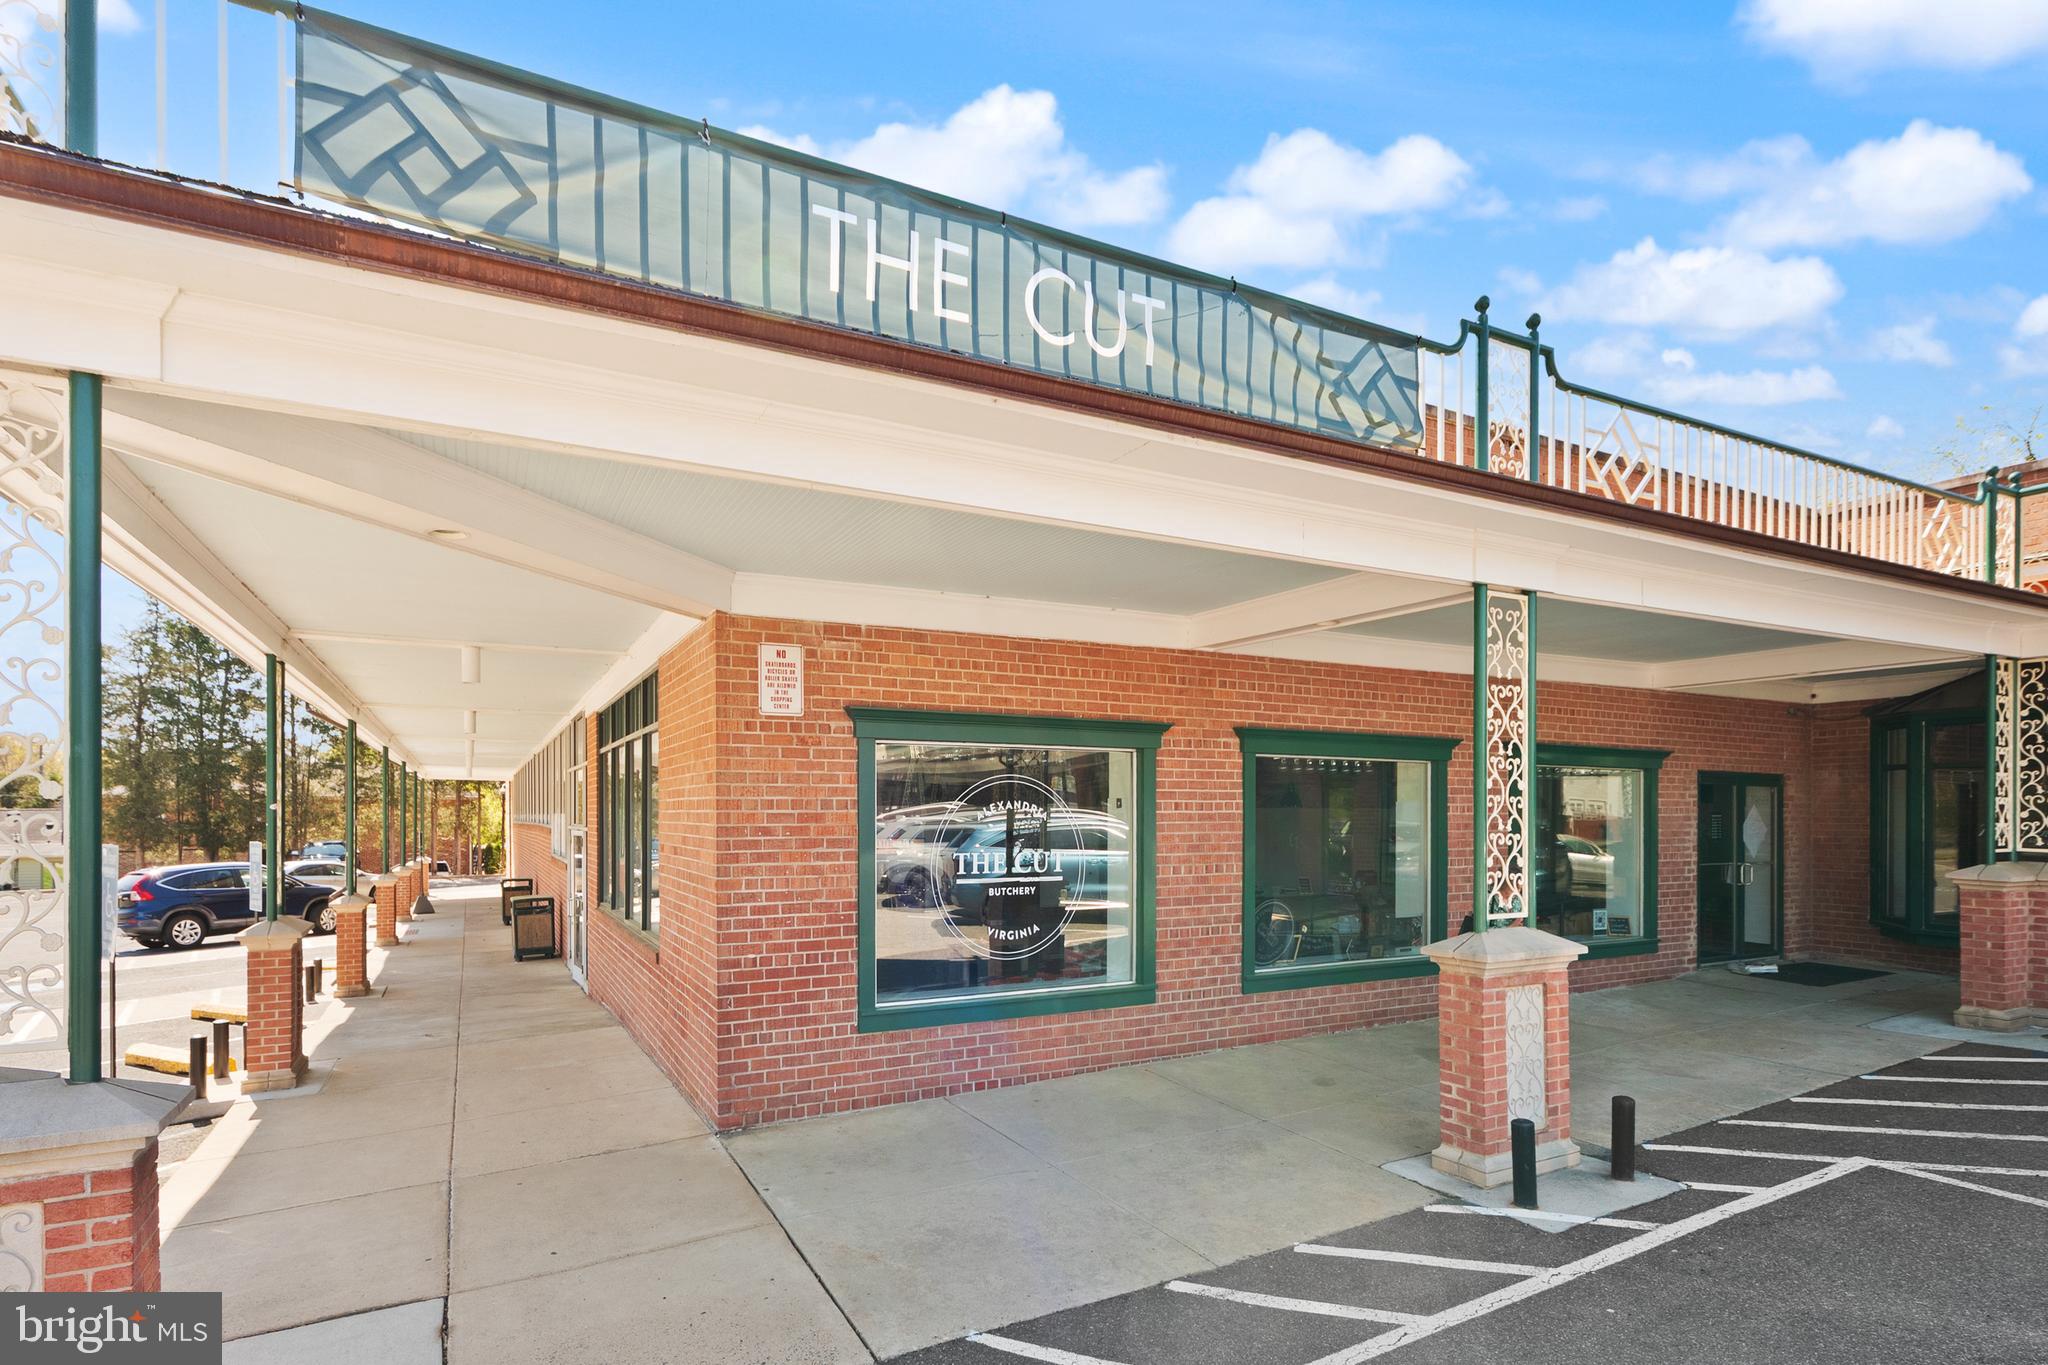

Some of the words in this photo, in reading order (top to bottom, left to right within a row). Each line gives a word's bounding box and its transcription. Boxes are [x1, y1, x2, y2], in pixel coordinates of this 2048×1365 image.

[812, 204, 970, 324] THE
[1024, 267, 1166, 367] CUT
[776, 649, 787, 659] NO
[977, 800, 1048, 822] ALEXANDRIA
[953, 852, 1008, 875] THE
[1013, 851, 1065, 874] CUT
[988, 886, 1037, 897] BUTCHERY
[987, 923, 1041, 941] VIRGINIA
